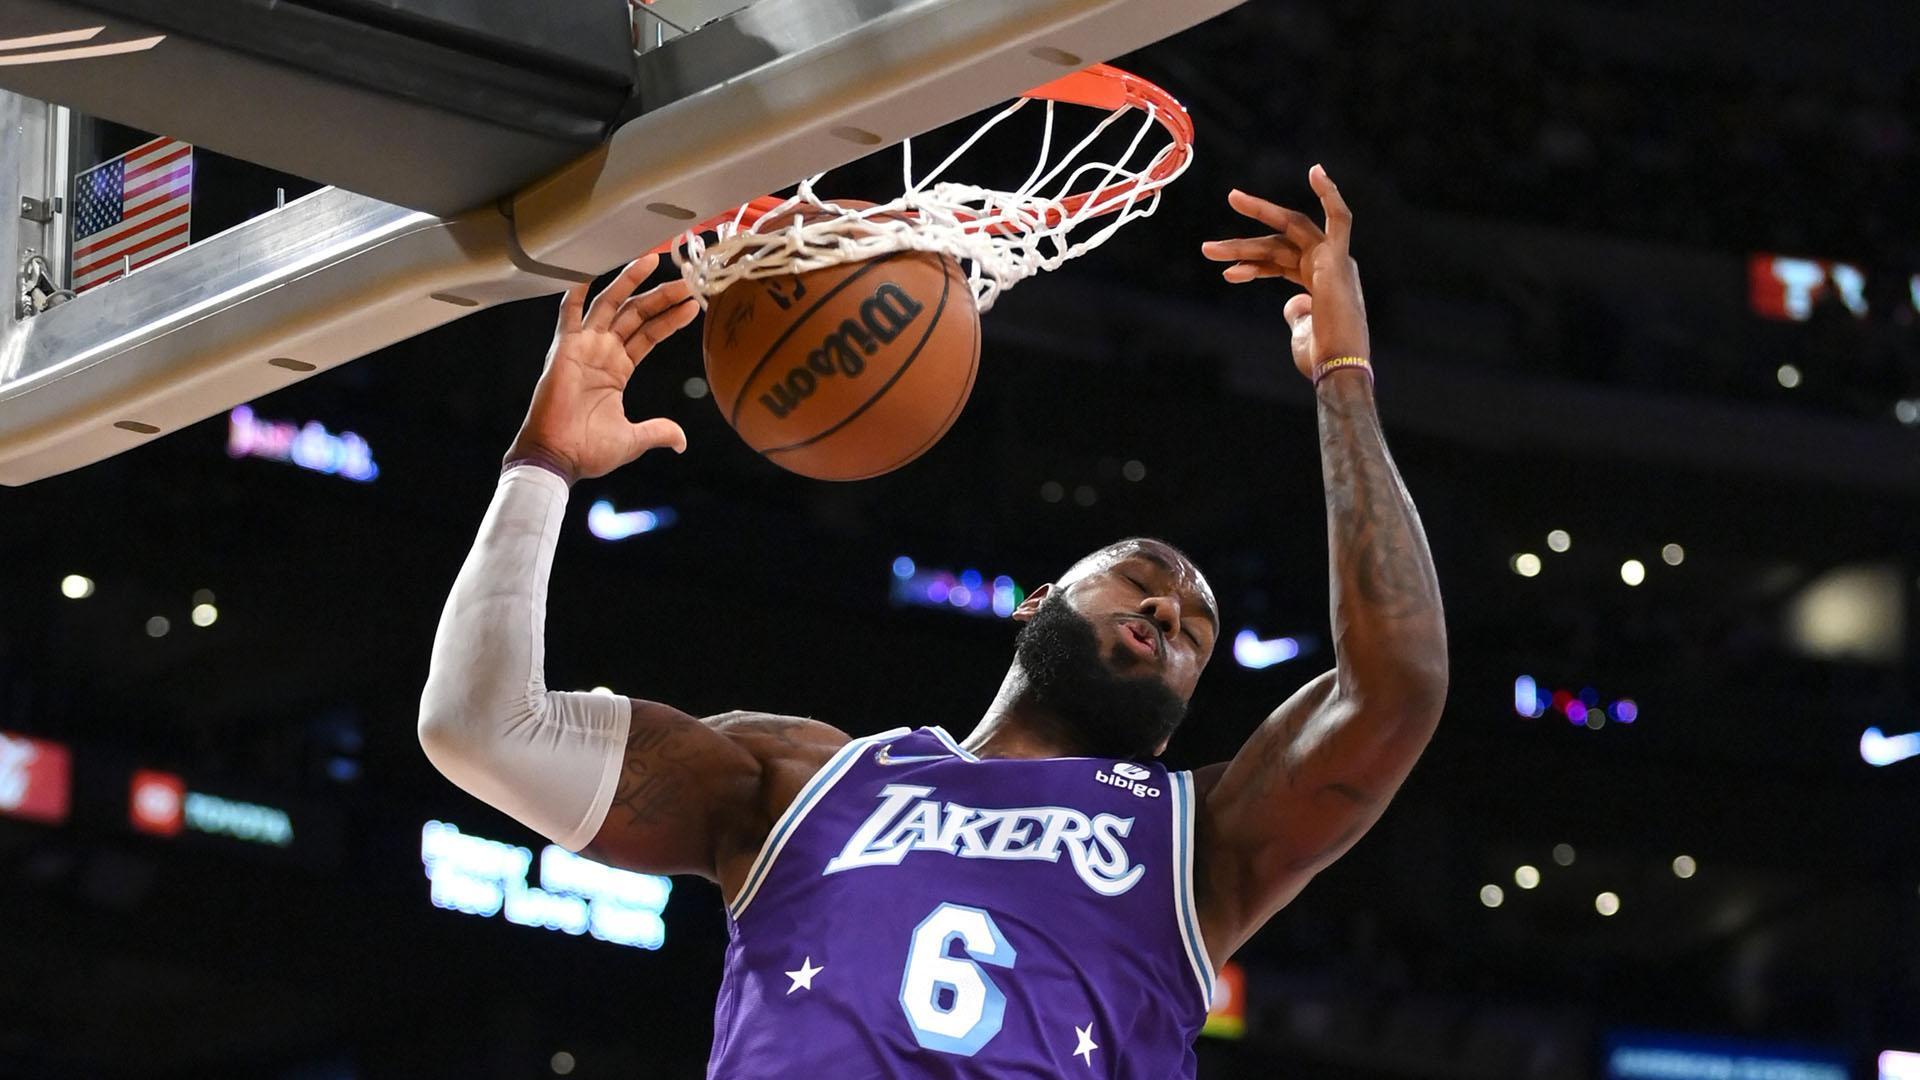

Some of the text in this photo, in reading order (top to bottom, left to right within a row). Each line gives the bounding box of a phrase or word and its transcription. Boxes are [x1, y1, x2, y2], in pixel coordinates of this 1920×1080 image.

[758, 281, 924, 419] Wilson
[823, 784, 1146, 896] LAKERS
[1095, 770, 1160, 797] bibigo
[898, 902, 1018, 1057] 6
